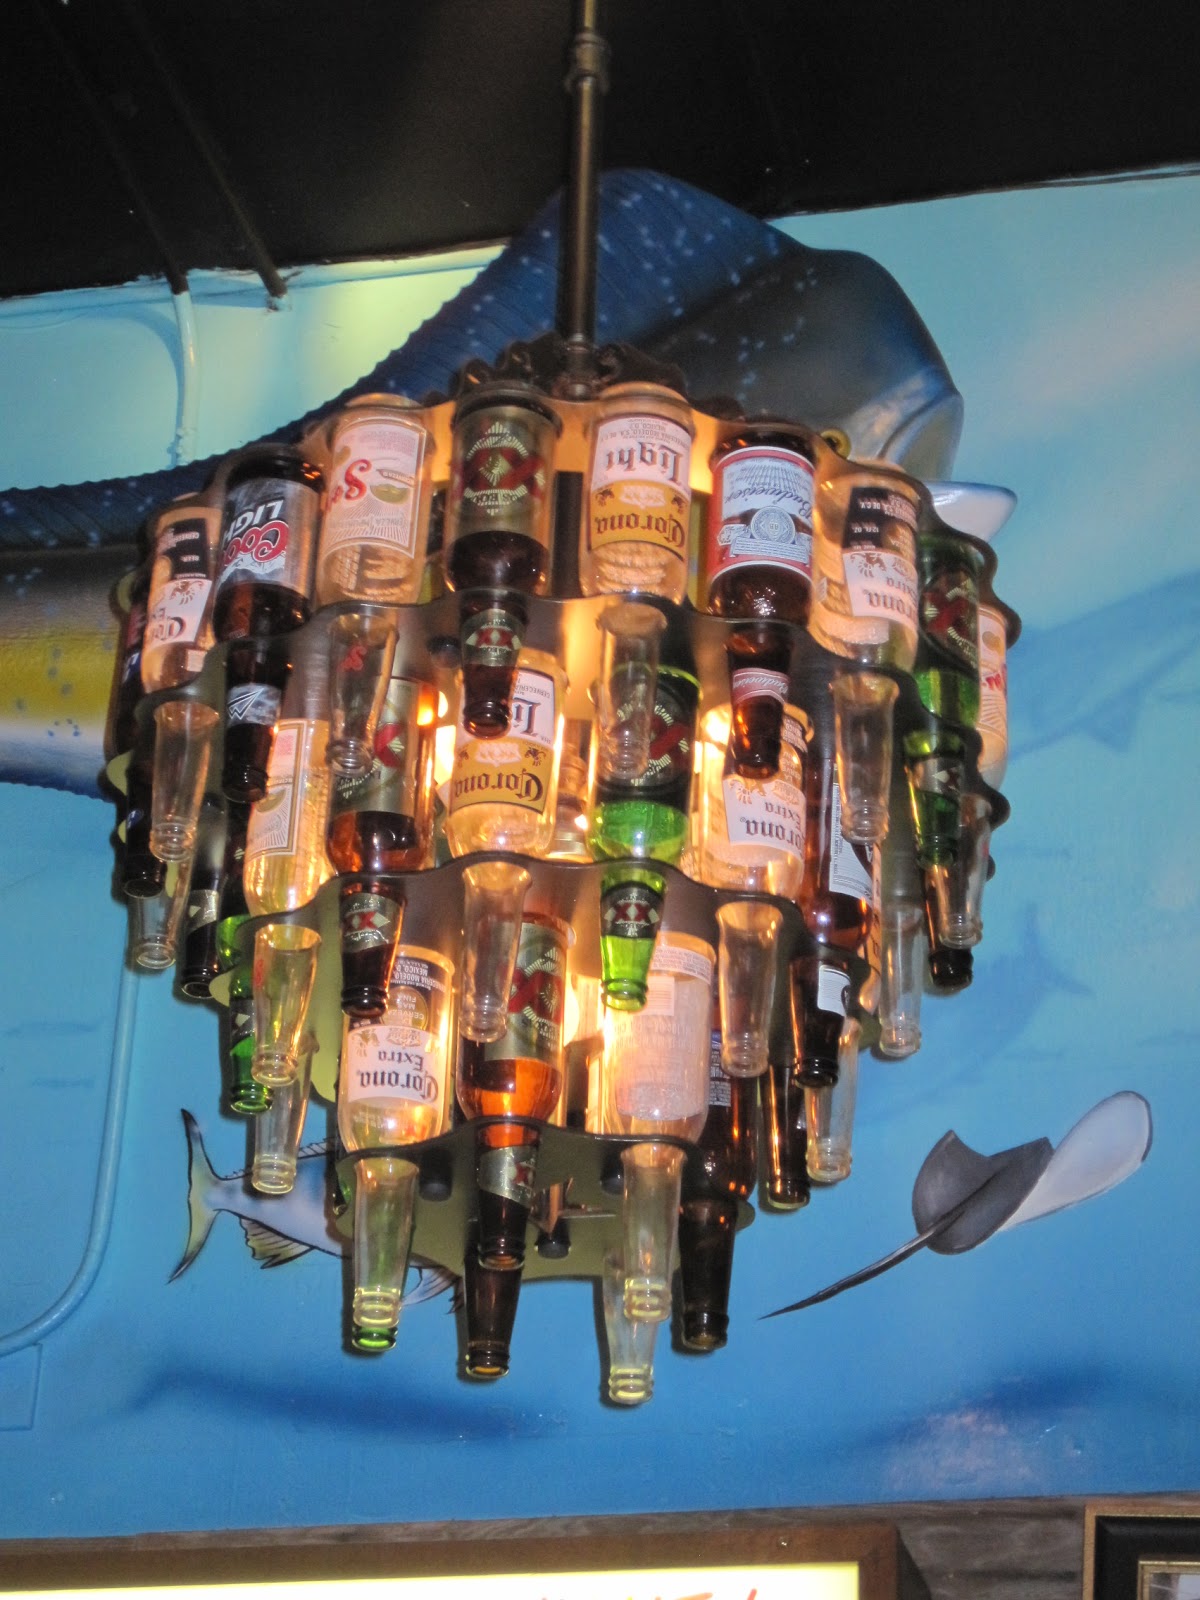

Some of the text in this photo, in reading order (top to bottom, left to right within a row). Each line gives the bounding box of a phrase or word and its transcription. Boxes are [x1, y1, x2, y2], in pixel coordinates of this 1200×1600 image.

[605, 442, 683, 486] Light
[724, 487, 812, 519] Budweiser
[594, 513, 686, 549] Corona
[454, 768, 543, 802] Corona
[744, 819, 804, 850] orona
[377, 1050, 424, 1072] Extra
[360, 1071, 438, 1102] Corona
